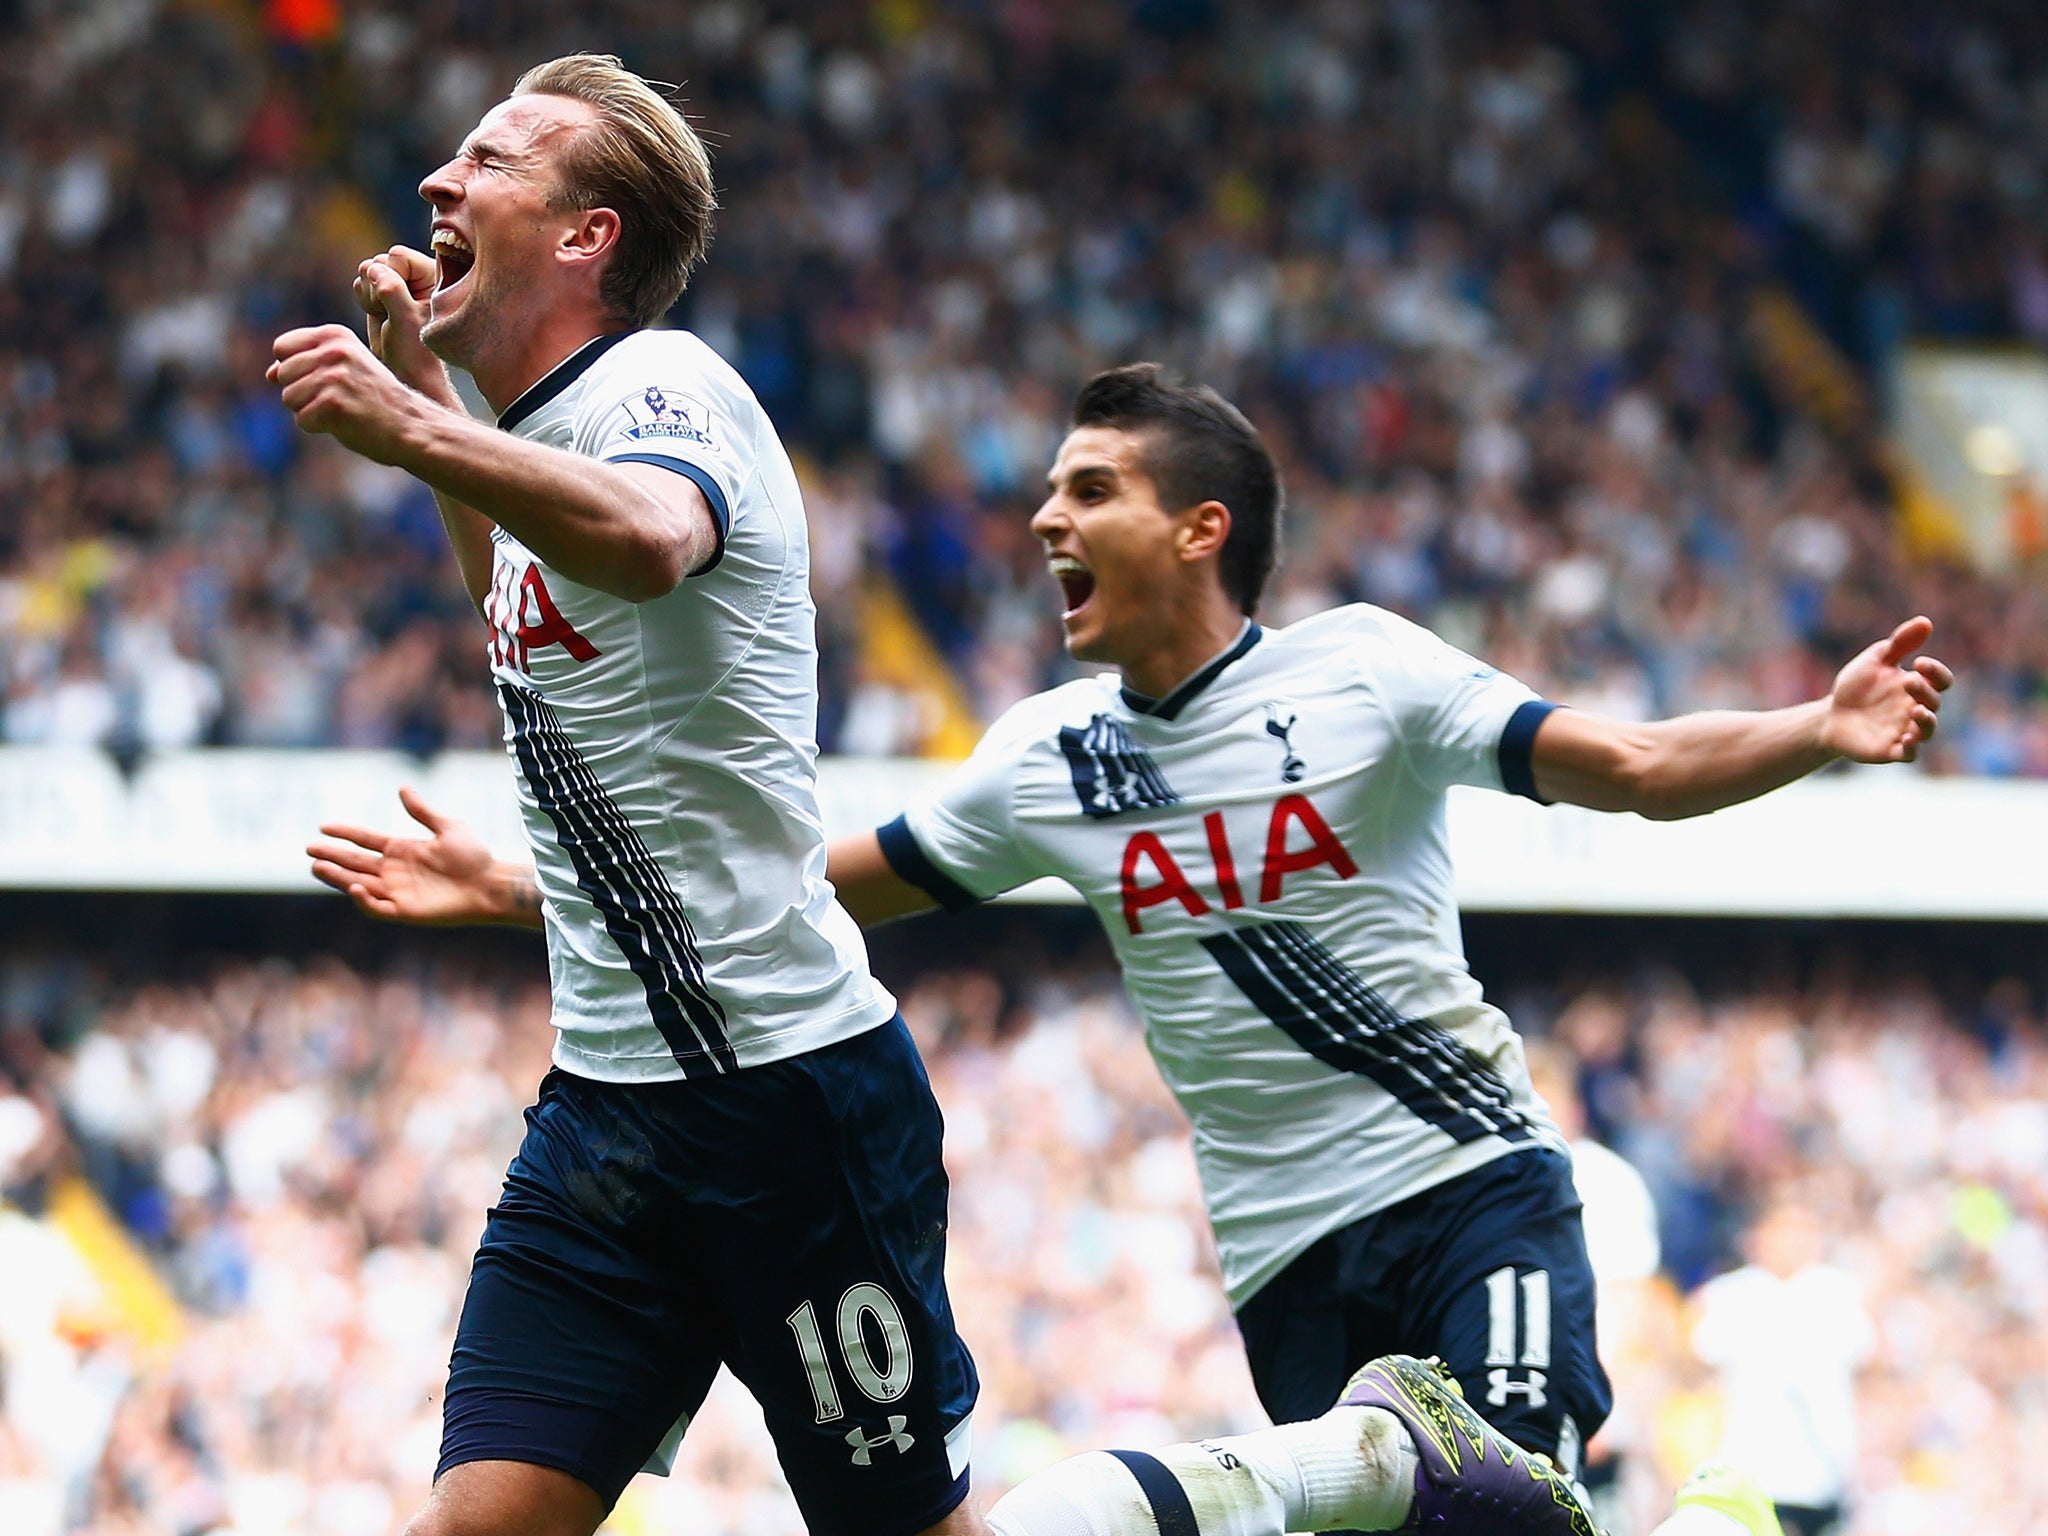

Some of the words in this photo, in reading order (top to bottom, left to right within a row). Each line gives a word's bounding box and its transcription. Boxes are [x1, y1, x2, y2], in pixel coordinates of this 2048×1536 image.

[1121, 794, 1360, 936] AIA
[786, 1281, 914, 1424] 10
[1484, 1266, 1550, 1369] 11
